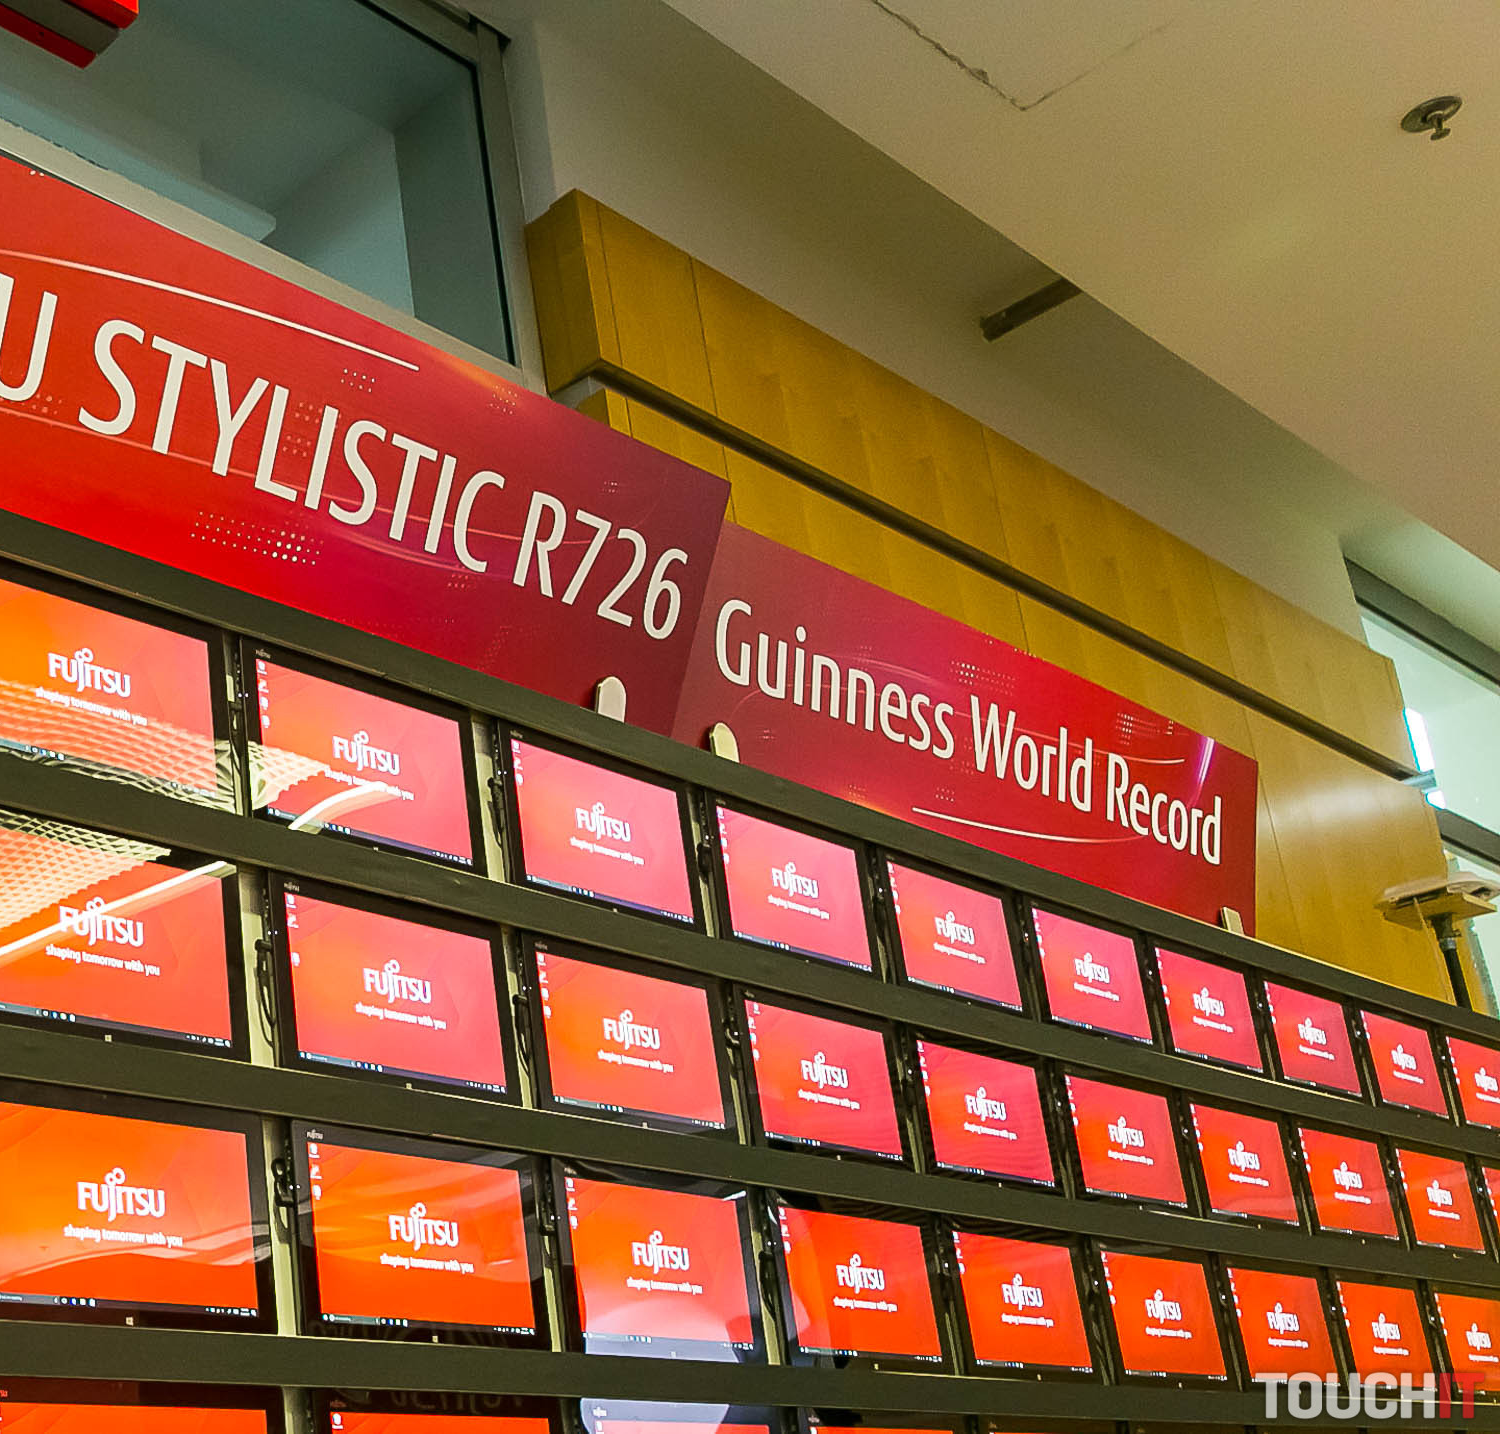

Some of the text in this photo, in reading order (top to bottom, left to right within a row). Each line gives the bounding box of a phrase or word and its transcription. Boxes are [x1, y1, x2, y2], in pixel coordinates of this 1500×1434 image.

[78, 320, 505, 573] STYLISTIC
[513, 490, 688, 640] R726
[48, 648, 130, 698] FUJITSU
[715, 599, 1221, 866] Guinness World Record
[332, 731, 399, 776] FUJITSU
[575, 802, 630, 842] FUJITSU
[771, 862, 818, 899] FUJITSU
[934, 912, 974, 945] FUJITSU
[364, 960, 431, 1003] FUJITSU
[604, 1010, 660, 1049] FUJITSU
[802, 1052, 848, 1088] FUJITSU
[966, 1087, 1006, 1121] FUJITSU
[78, 1168, 165, 1221] FUJITSU
[388, 1203, 458, 1247] FUJITSU
[632, 1231, 689, 1274] FUJITSU
[837, 1254, 884, 1293] FUJITSU
[1003, 1274, 1043, 1310] FUJITSU
